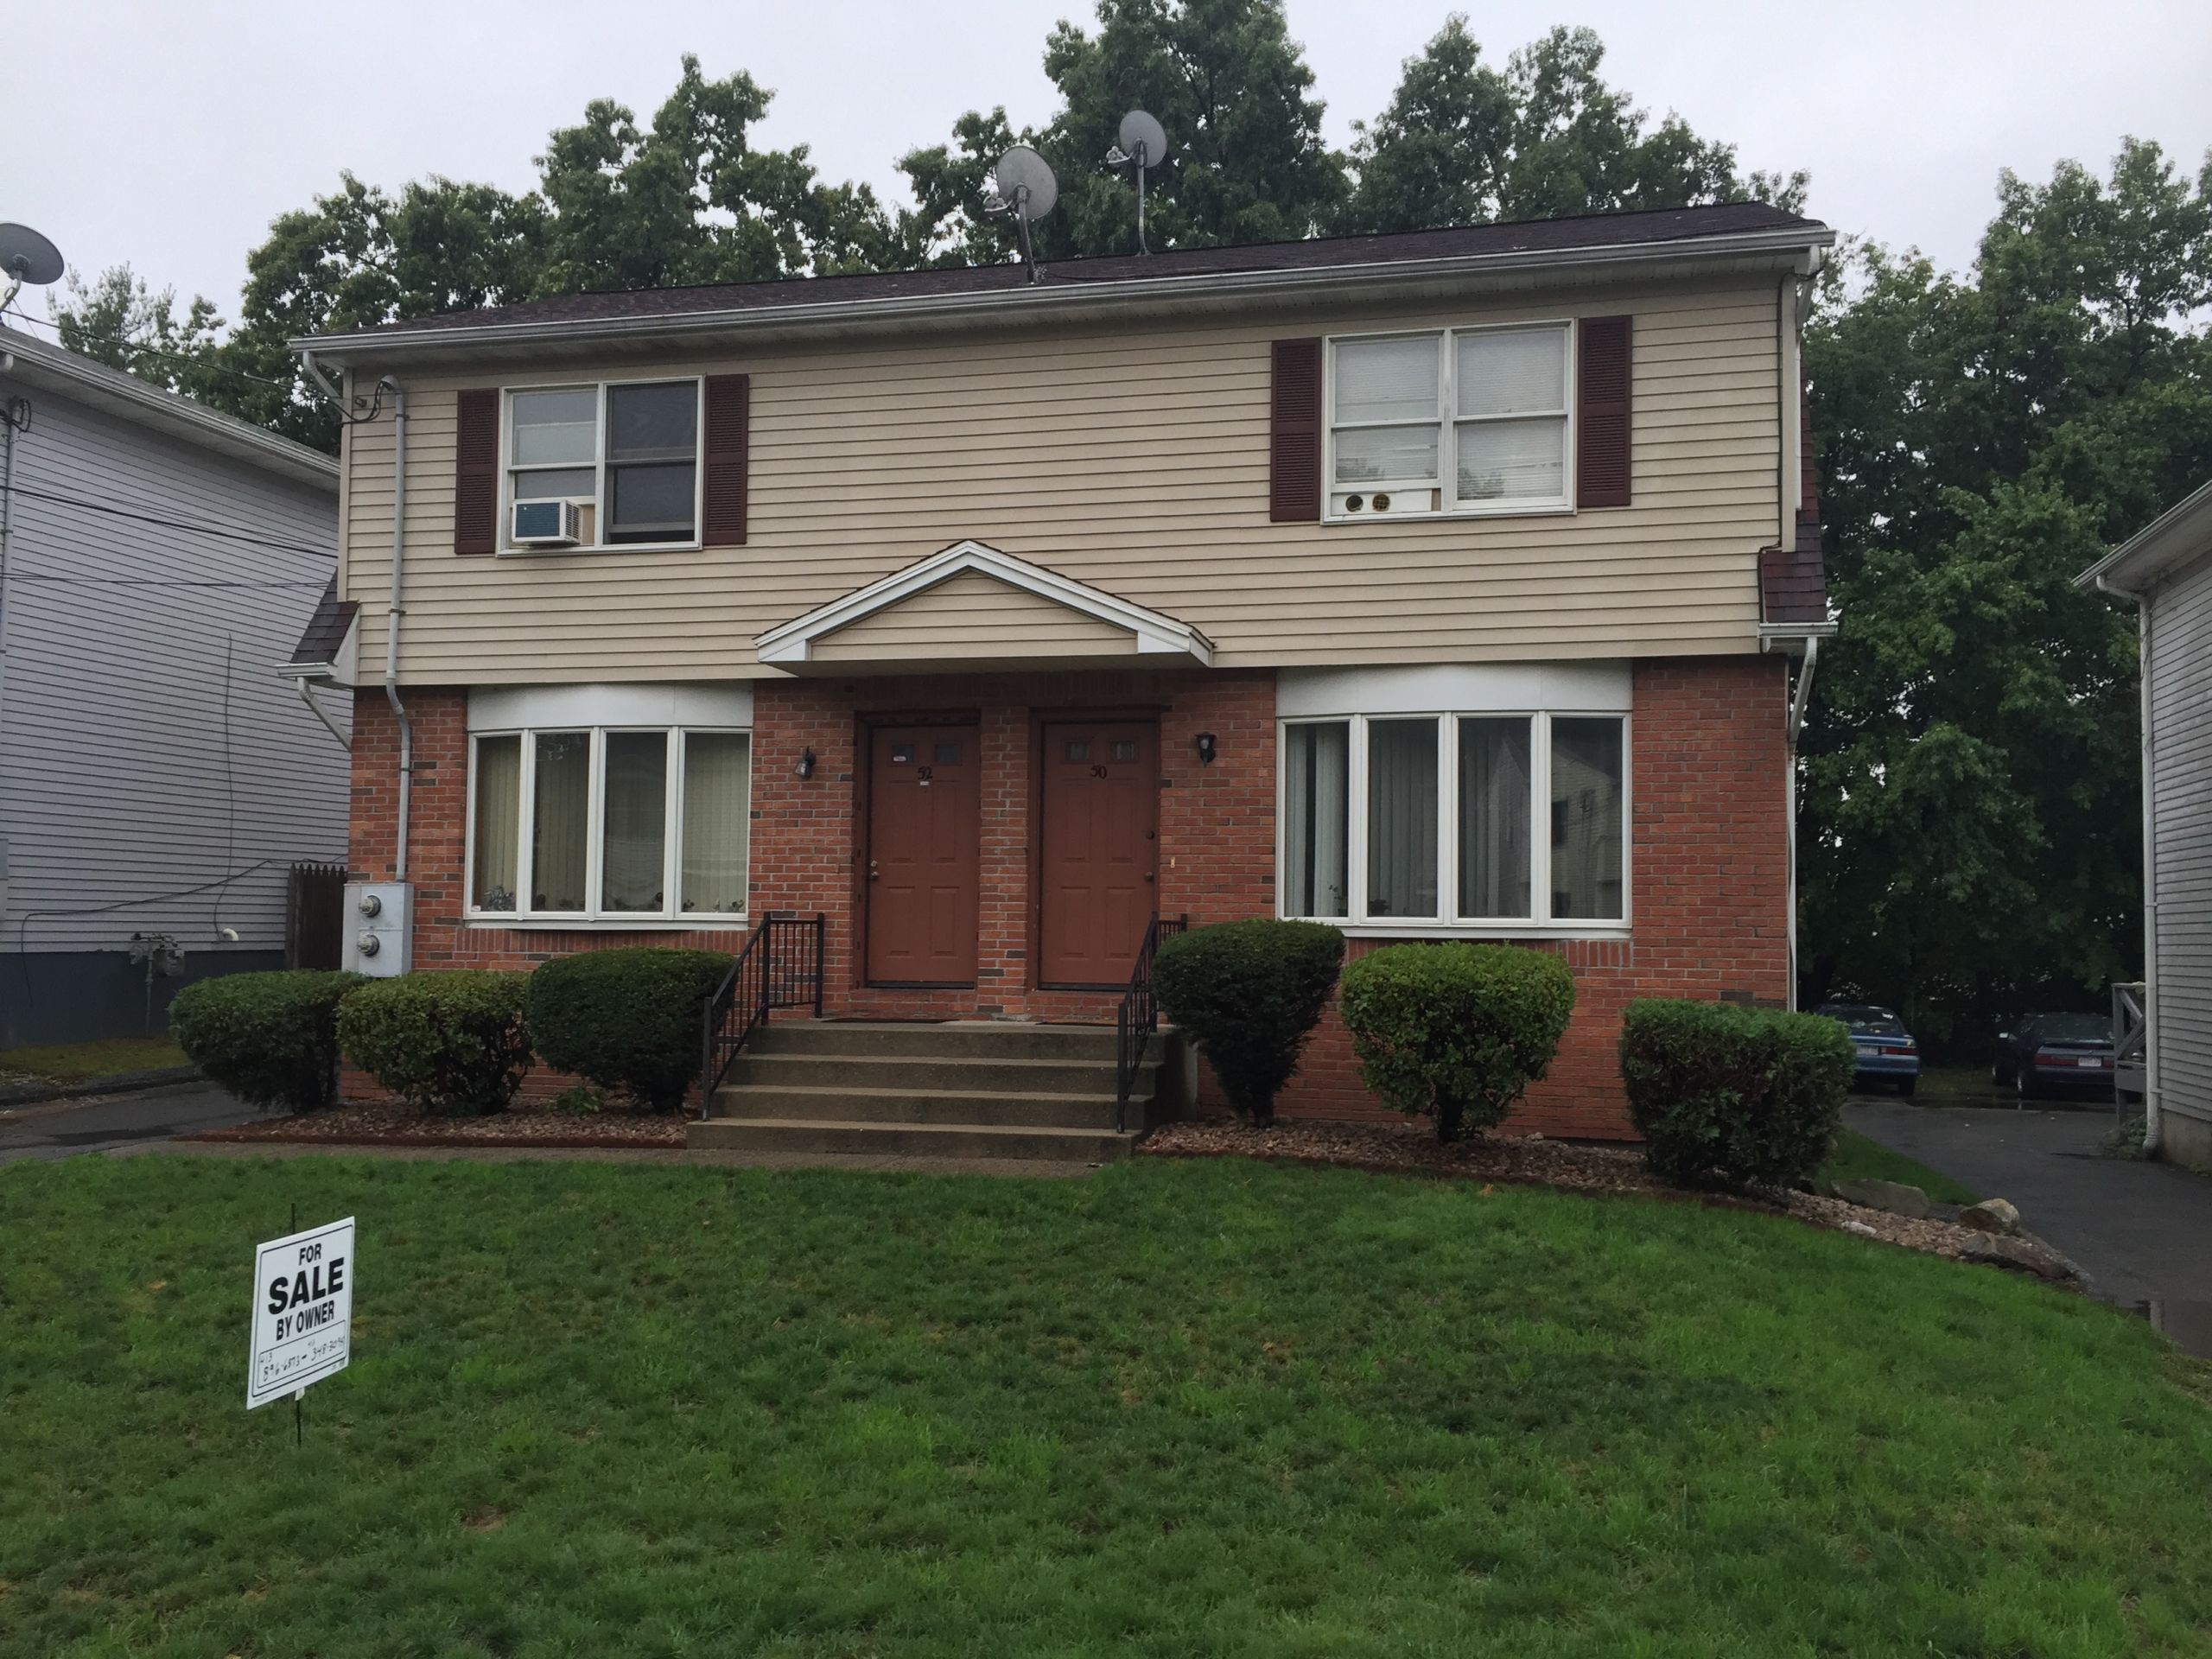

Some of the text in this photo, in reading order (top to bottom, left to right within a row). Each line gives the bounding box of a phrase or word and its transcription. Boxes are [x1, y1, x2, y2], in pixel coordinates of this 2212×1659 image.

[918, 766, 933, 780] 52
[1090, 765, 1107, 779] 50
[298, 1243, 321, 1266] FOR
[268, 1256, 345, 1315] SALE
[276, 1300, 334, 1341] BY OWNER
